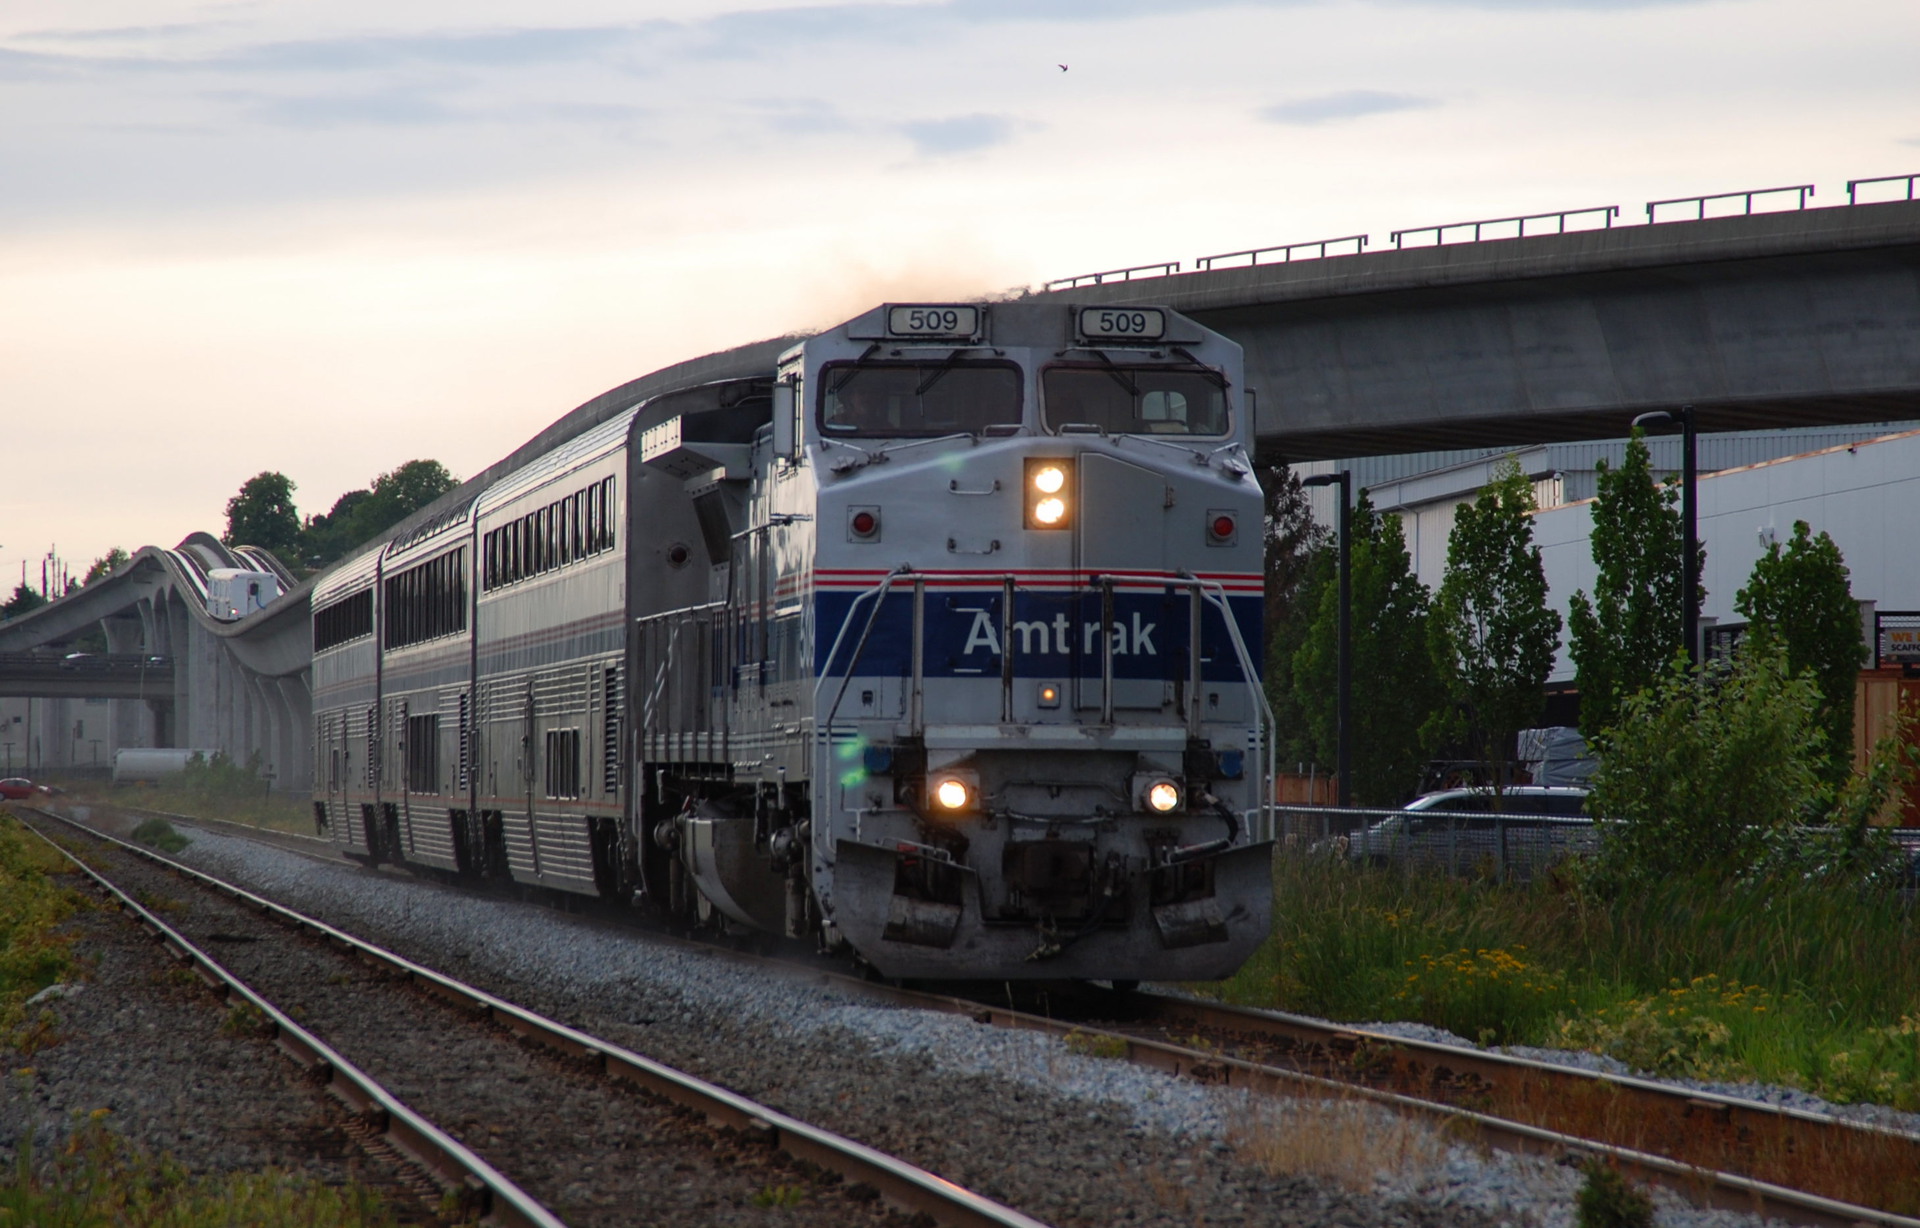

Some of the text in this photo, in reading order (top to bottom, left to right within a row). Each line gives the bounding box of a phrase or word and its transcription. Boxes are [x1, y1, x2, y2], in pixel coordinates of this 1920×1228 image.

[909, 310, 959, 331] 509
[1100, 312, 1147, 333] 509
[963, 611, 1157, 655] Amtrak
[1891, 632, 1912, 643] WE
